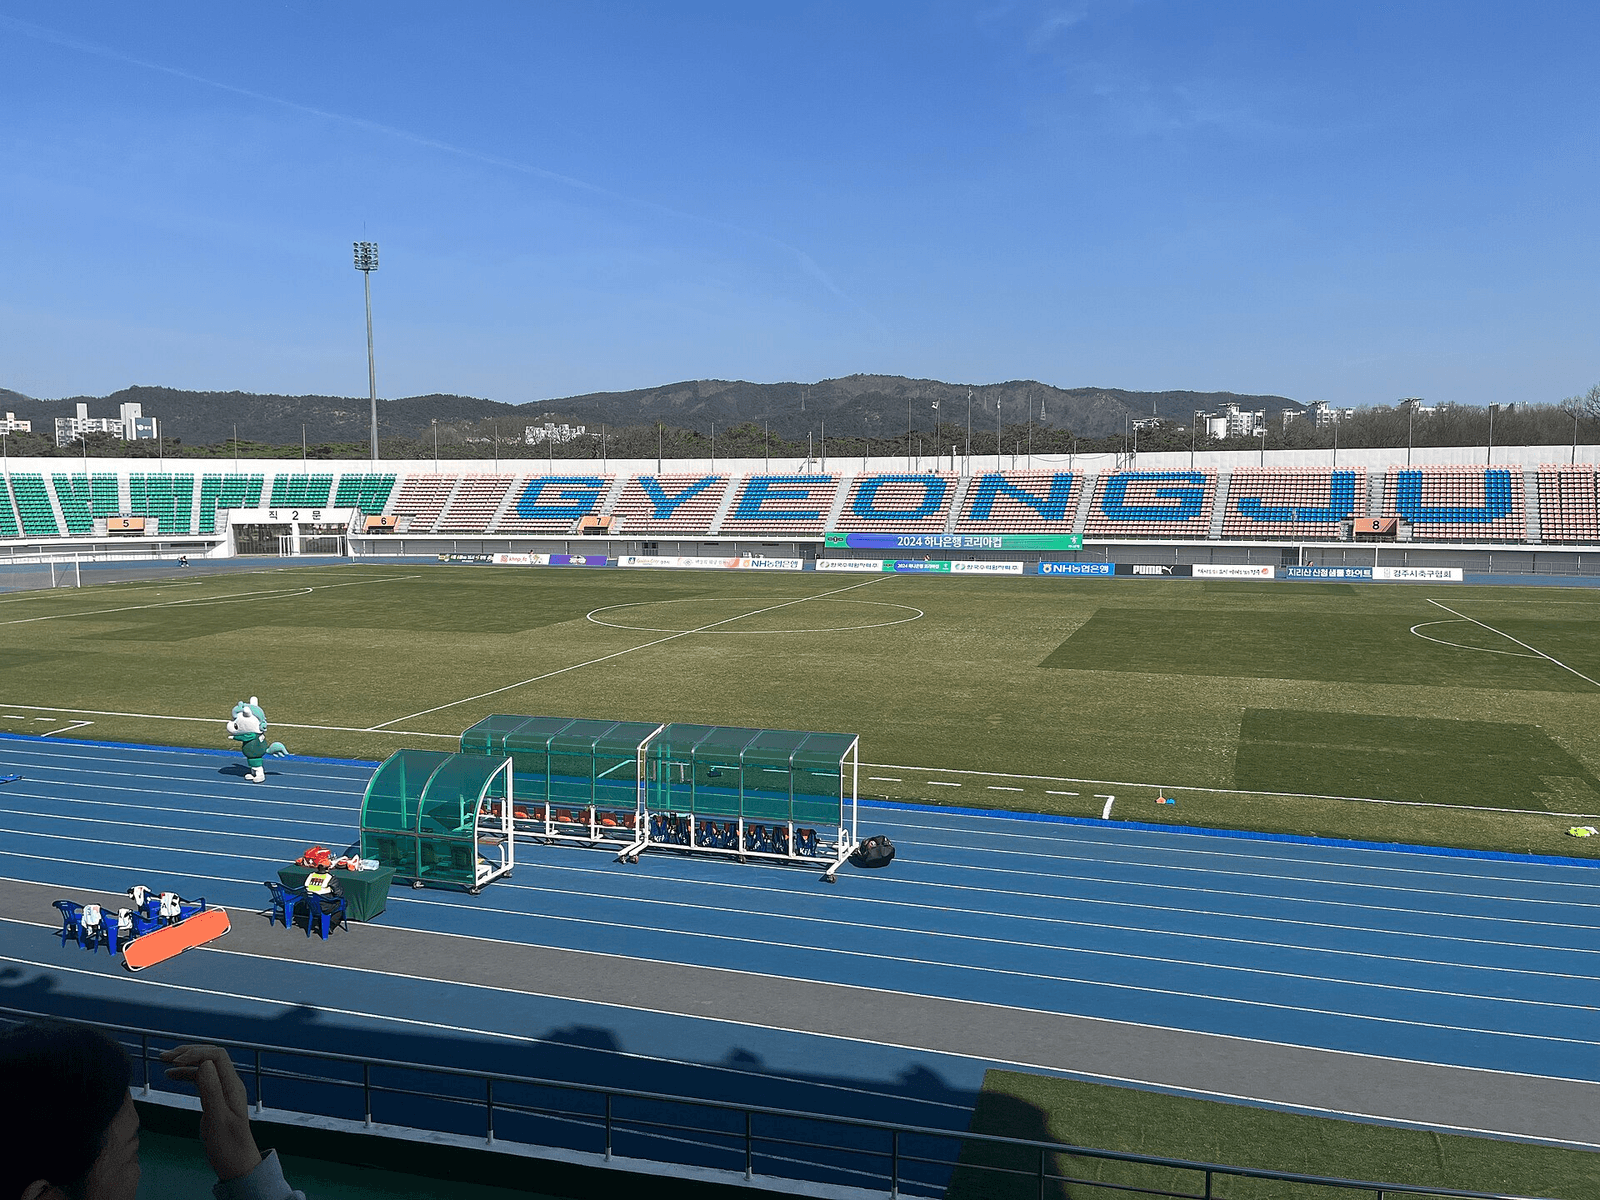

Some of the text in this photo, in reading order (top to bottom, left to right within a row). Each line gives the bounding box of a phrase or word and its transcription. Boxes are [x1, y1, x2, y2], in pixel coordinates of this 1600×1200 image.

[515, 469, 1513, 523] GYEONGJU
[268, 510, 322, 521] 직 2 문
[122, 519, 130, 528] 5
[380, 516, 388, 525] 6
[596, 517, 602, 526] 7
[1372, 520, 1380, 530] 8
[896, 536, 1003, 548] 2024 하나은행 코리아컵
[1053, 564, 1109, 573] NH농협은행
[1132, 565, 1163, 575] PUMA
[1288, 568, 1311, 577] 지리산
